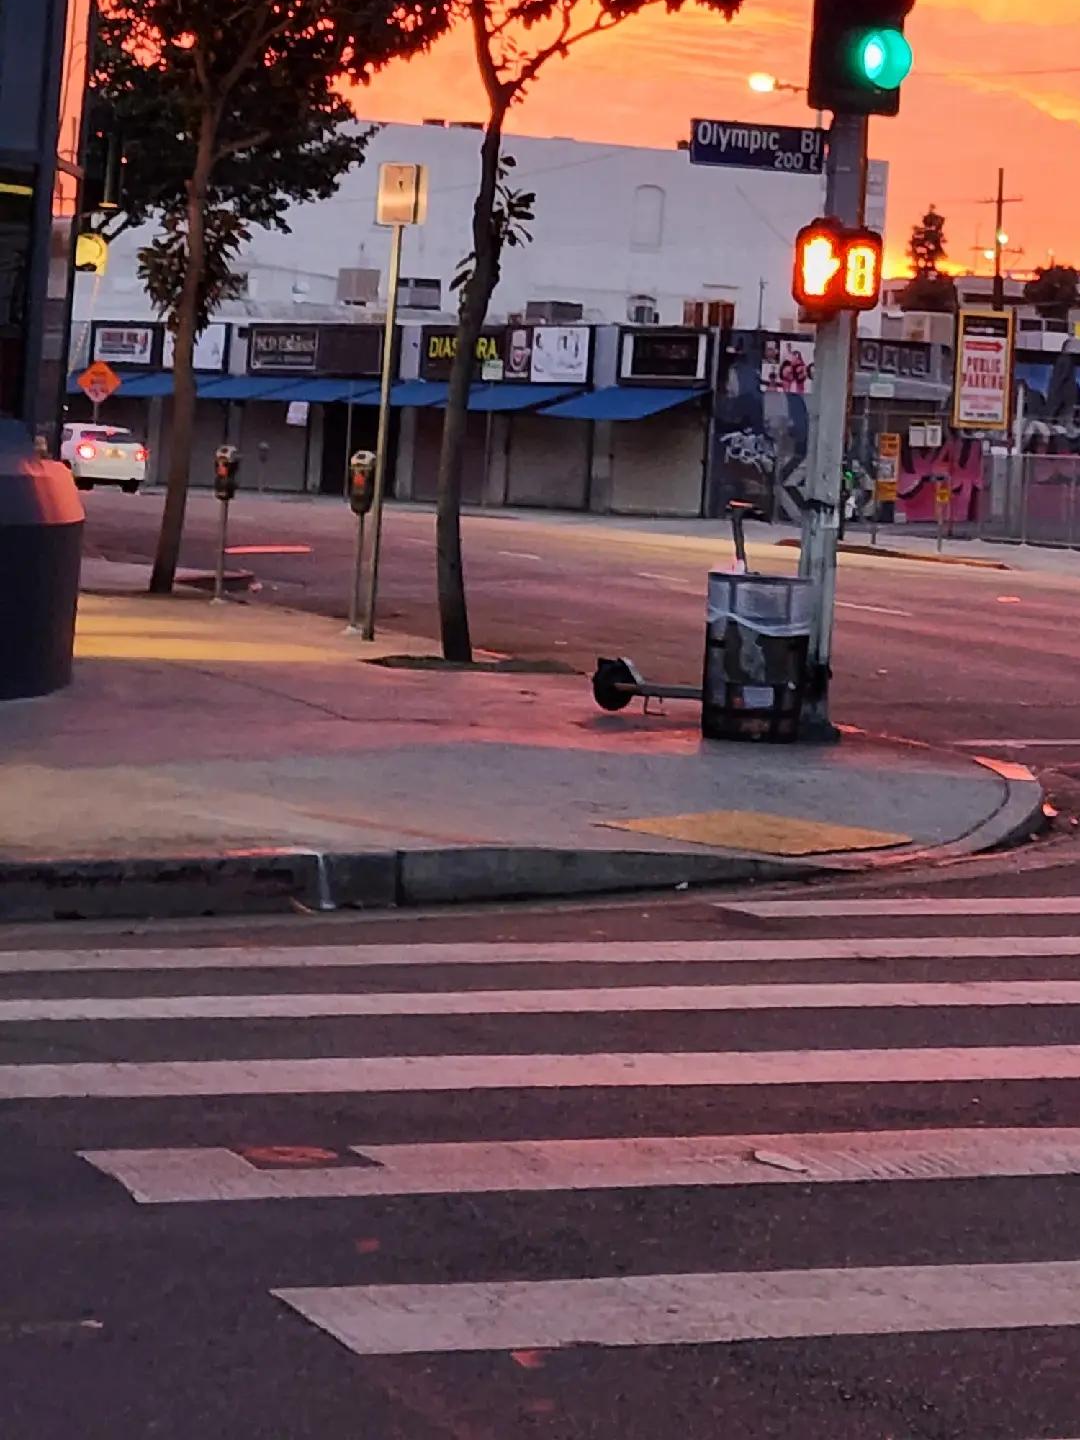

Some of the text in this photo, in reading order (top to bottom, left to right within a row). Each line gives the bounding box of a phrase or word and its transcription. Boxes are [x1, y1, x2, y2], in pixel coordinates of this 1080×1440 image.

[698, 121, 780, 154] Olympic
[774, 151, 818, 170] 200 E
[428, 336, 498, 359] DIASRA
[967, 356, 1001, 373] PUBLIC
[961, 373, 1004, 390] PARKING
